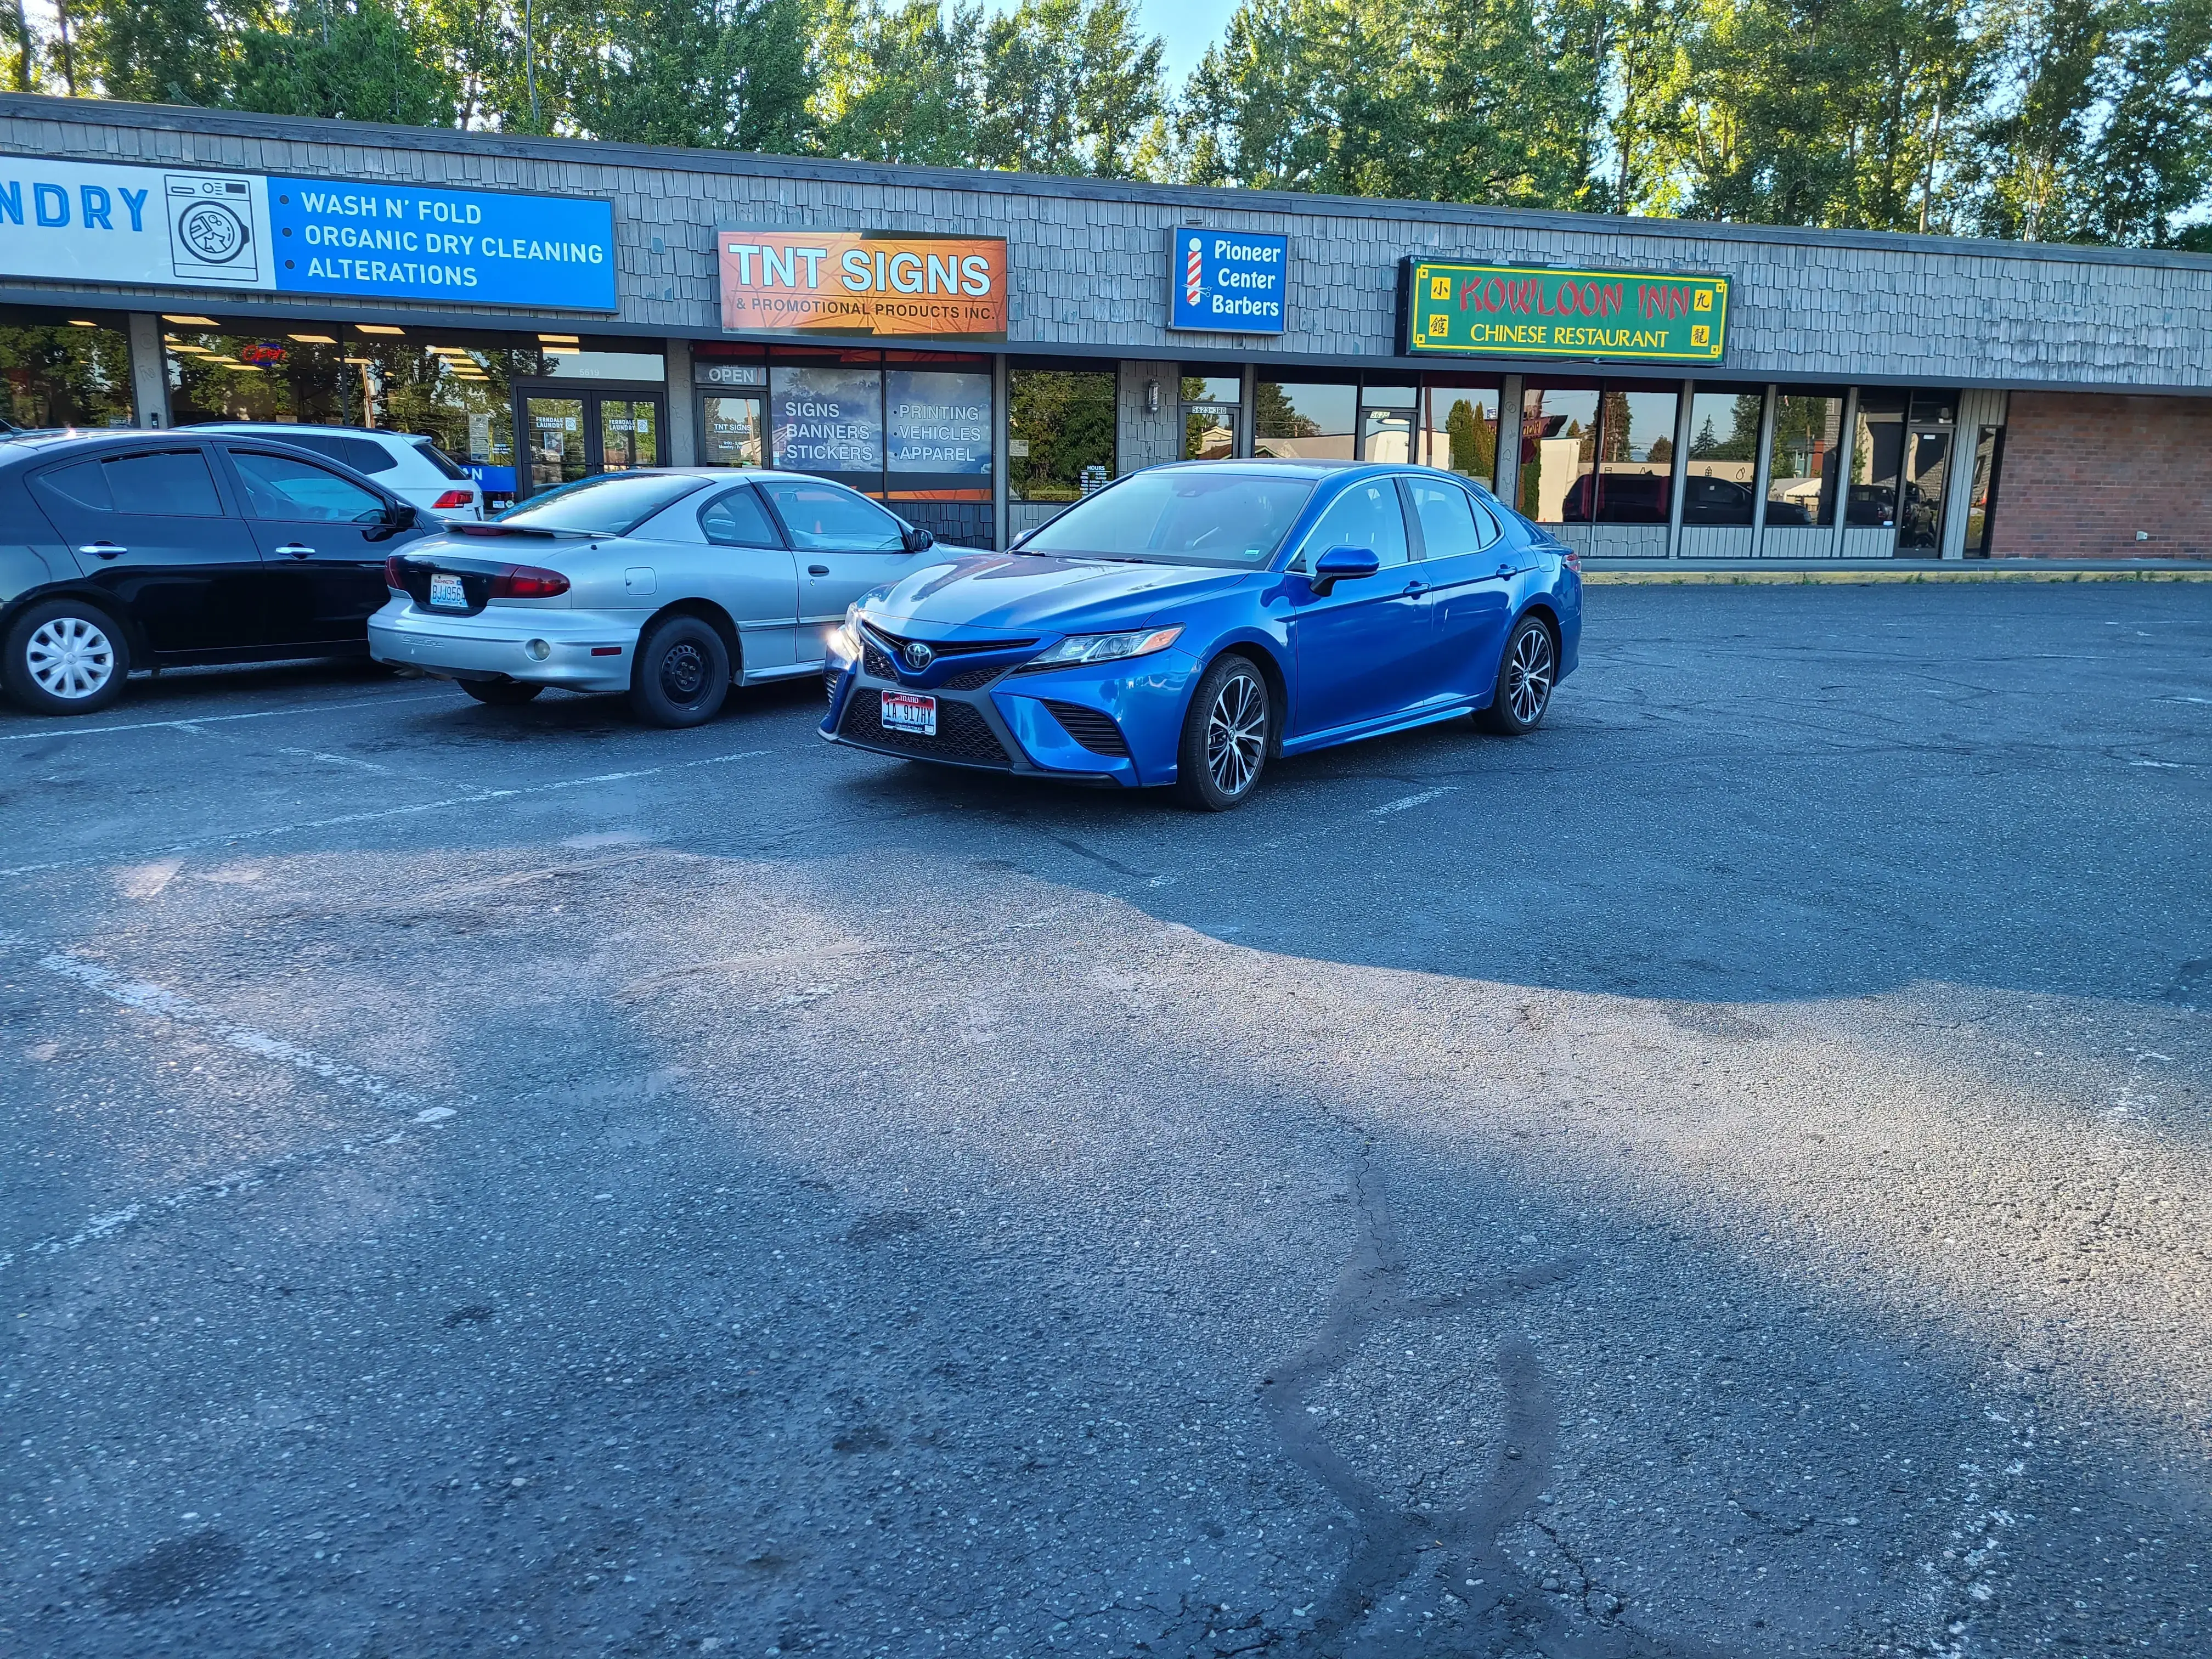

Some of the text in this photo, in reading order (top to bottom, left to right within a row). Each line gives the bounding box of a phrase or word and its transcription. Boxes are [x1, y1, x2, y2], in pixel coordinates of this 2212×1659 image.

[0, 180, 149, 232] NDRY
[301, 191, 481, 224] WASH N' FOLD
[305, 224, 603, 264] ORGANIC DRY CLEANING
[1214, 239, 1281, 263] Pioneer
[307, 257, 478, 287] ALTERATIONS
[728, 243, 992, 297] TNT SIGNS
[1217, 267, 1276, 290] Center
[1212, 294, 1279, 317] Barbers
[1458, 275, 1691, 320] KOWLOON INN
[736, 298, 996, 320] & PROMOTIONAL PRODUCTS INC.
[1470, 324, 1669, 348] CHINESE RESTAURANT
[709, 368, 754, 383] OPEN
[785, 402, 840, 418] SIGNS
[899, 404, 980, 421] PRINTING
[786, 423, 871, 440] BANNERS
[899, 425, 981, 442] VEHICLES
[786, 444, 873, 461] STICKERS
[899, 446, 976, 462] APPAREL
[900, 695, 919, 703] IDAHO
[886, 702, 932, 724] 1A 917HY
